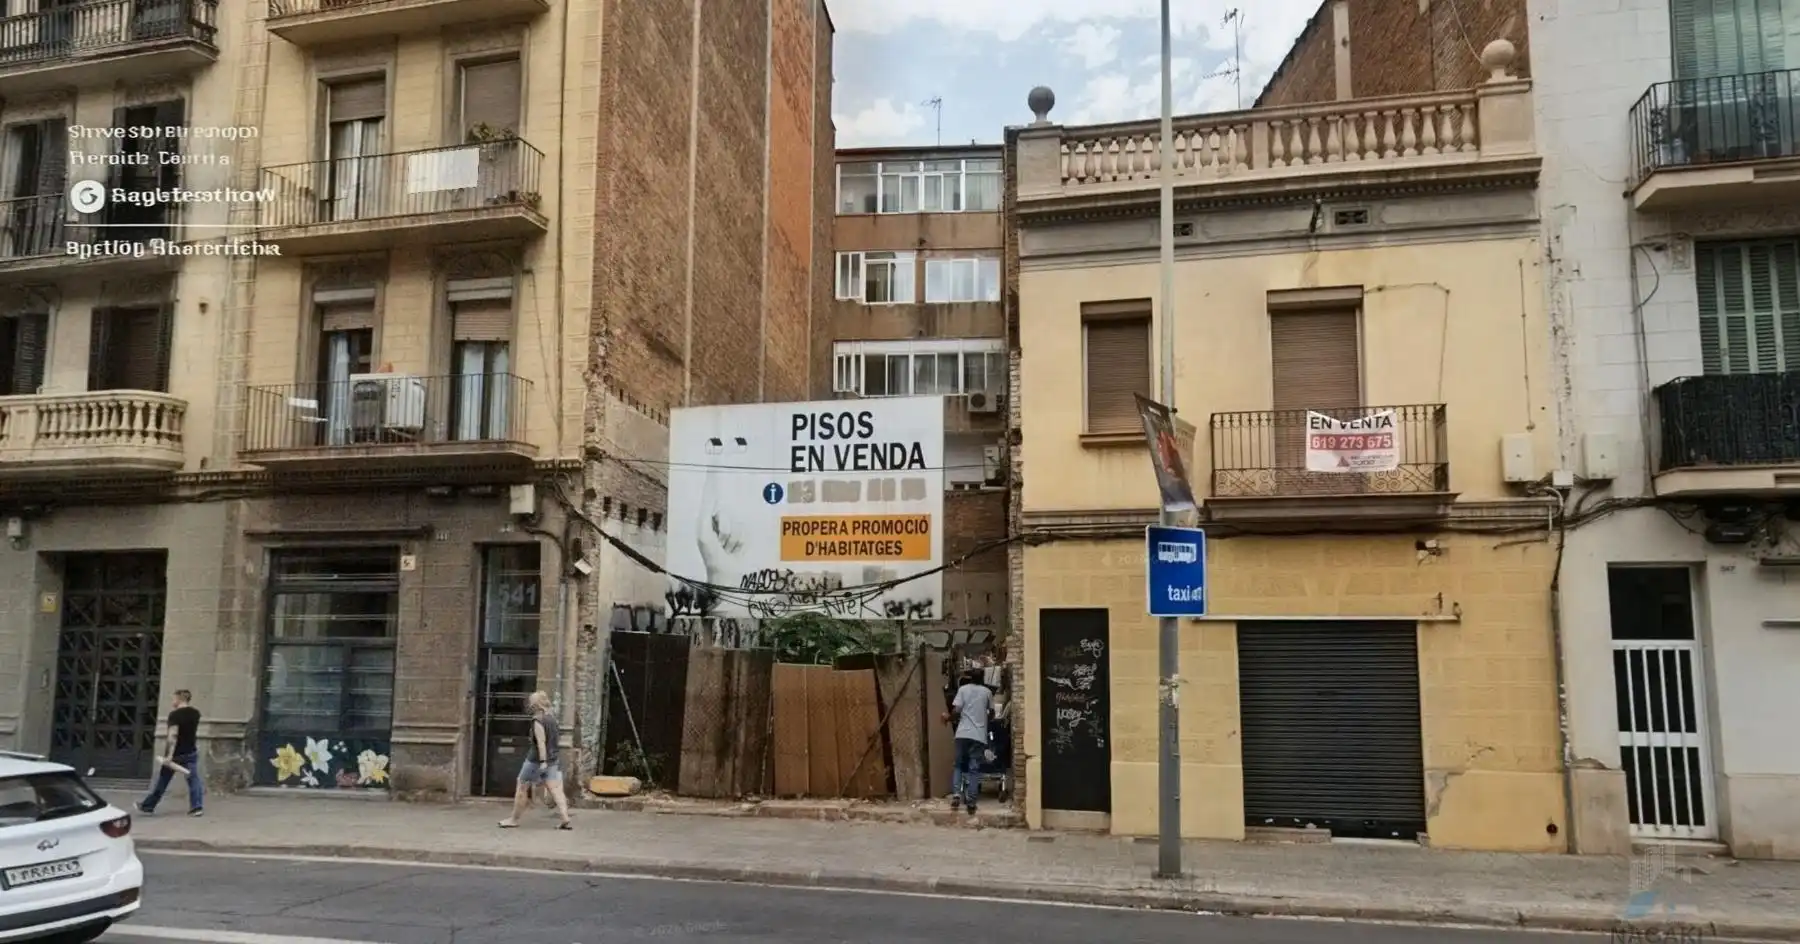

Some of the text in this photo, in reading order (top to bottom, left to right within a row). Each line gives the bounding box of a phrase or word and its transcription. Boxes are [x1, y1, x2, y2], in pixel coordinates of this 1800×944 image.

[791, 411, 874, 440] PISOS
[1310, 415, 1392, 429] EN VENTA
[1312, 435, 1392, 449] 619 273 675
[790, 441, 927, 473] EN VENDA
[782, 516, 929, 536] PROPERA PROMOCIÓ
[805, 540, 903, 556] D'HABITATGES
[1167, 584, 1190, 601] taxi
